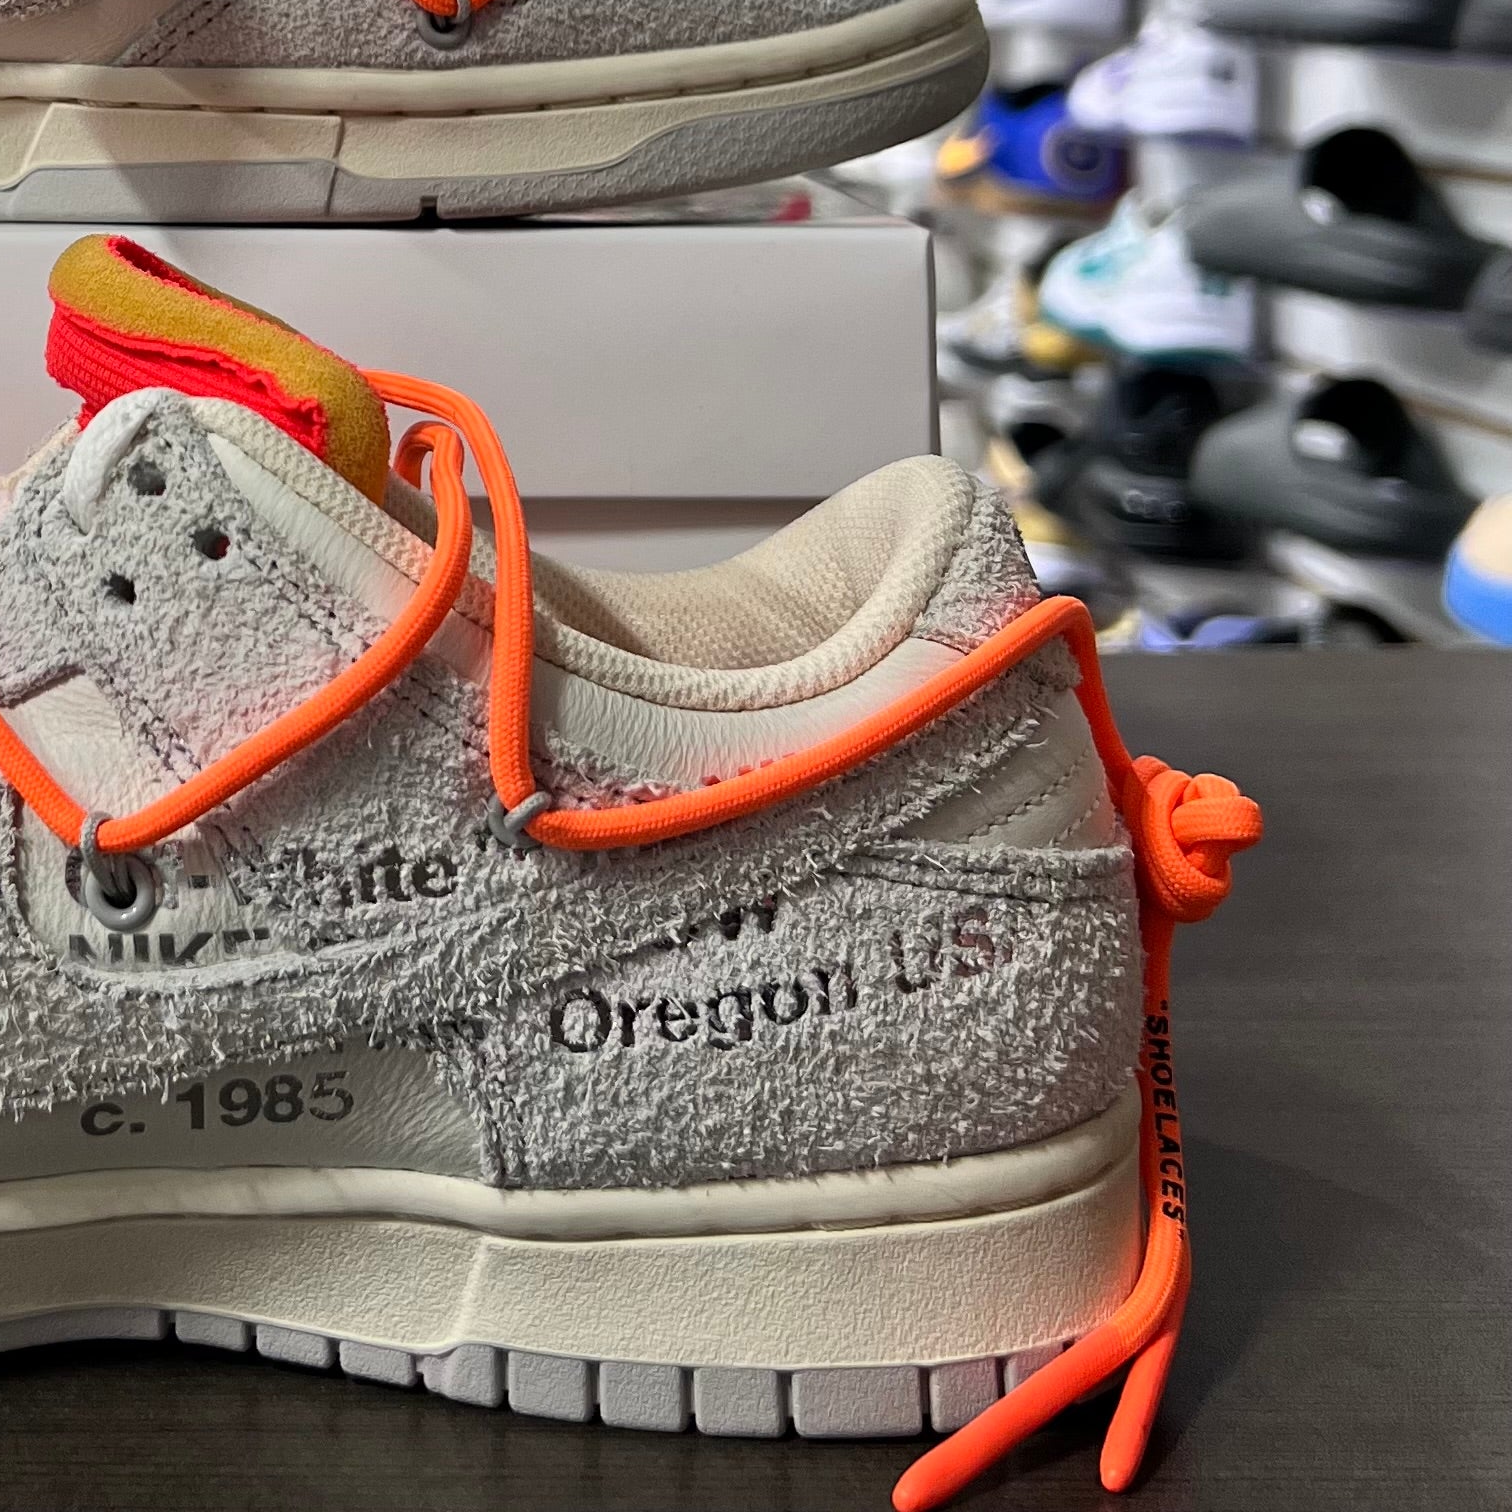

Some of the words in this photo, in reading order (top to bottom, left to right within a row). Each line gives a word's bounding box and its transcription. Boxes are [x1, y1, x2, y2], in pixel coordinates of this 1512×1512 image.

[550, 963, 857, 1052] Oregon
[893, 905, 1013, 994] US
[80, 1101, 146, 1136] c.
[176, 1070, 354, 1130] 1985
